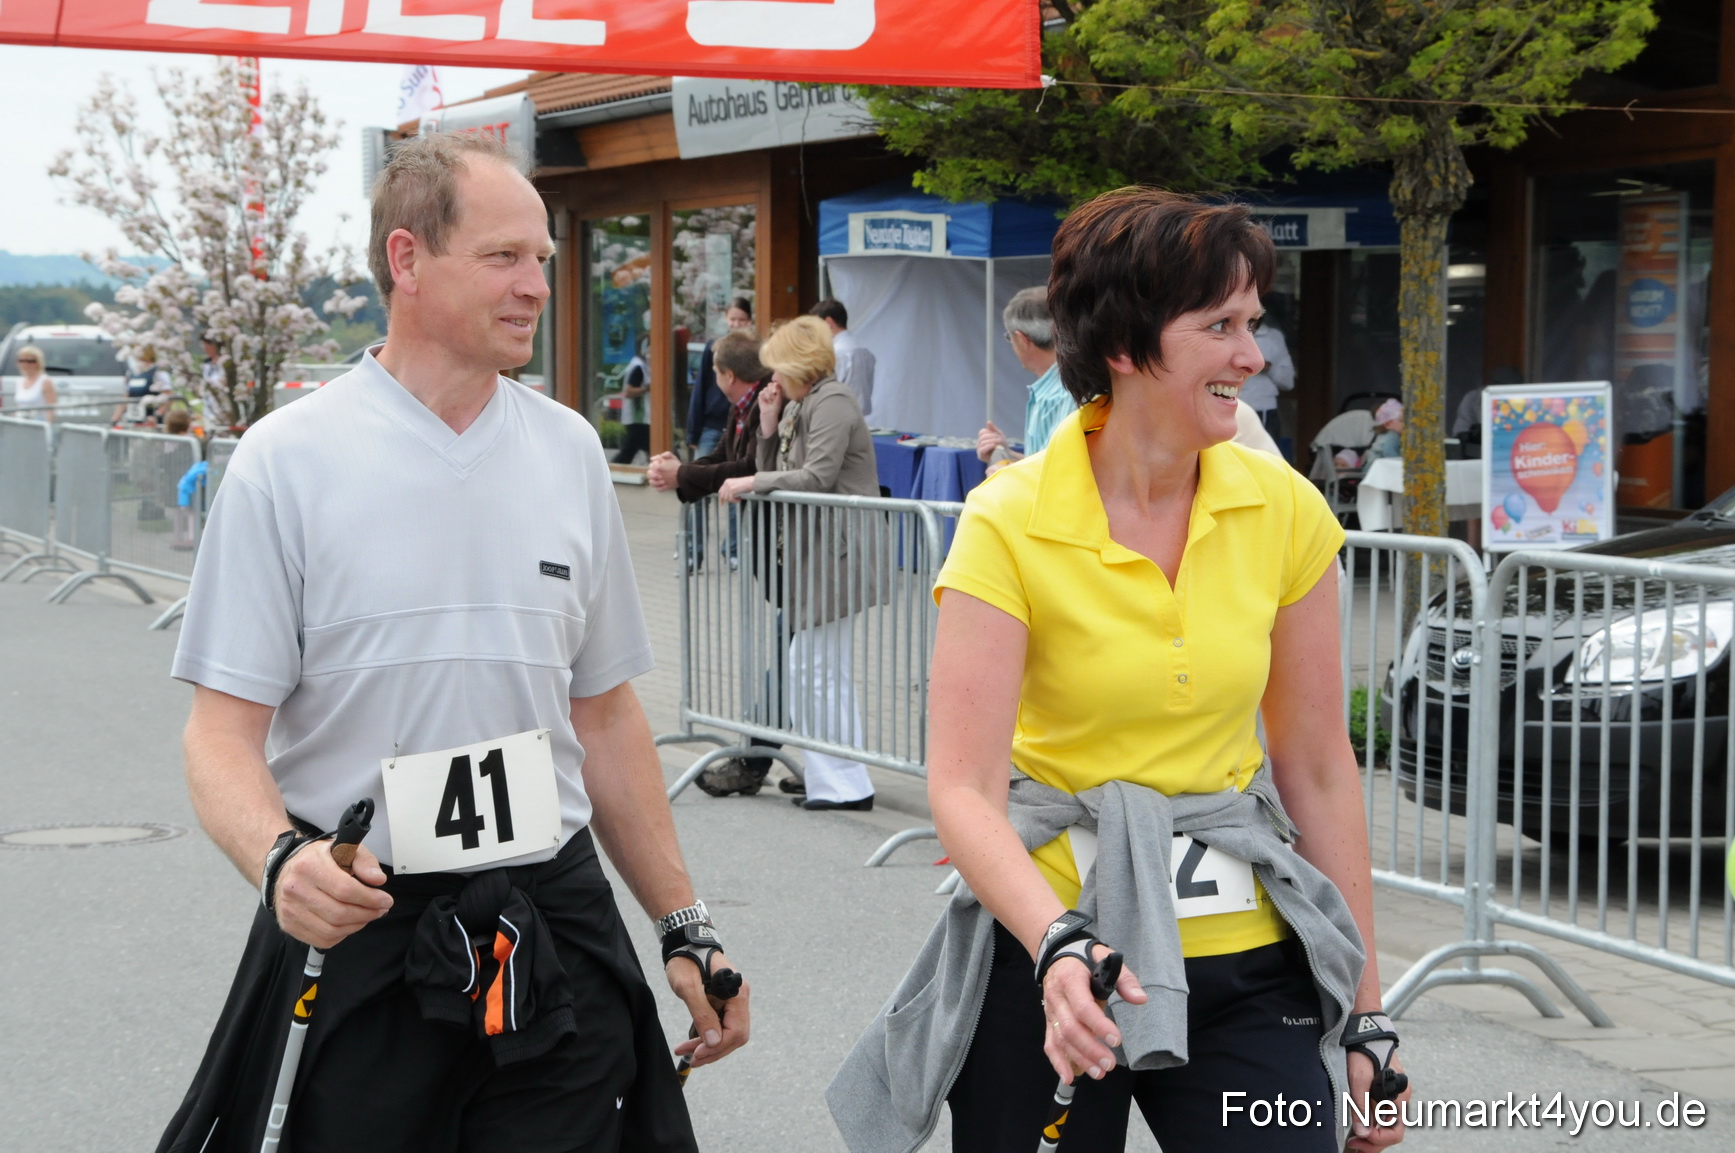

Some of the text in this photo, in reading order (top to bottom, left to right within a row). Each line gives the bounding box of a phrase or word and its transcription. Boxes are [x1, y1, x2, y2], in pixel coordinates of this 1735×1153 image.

[689, 86, 768, 127] Autohaus
[1514, 453, 1575, 469] Kinder-
[434, 747, 515, 851] 41
[1169, 831, 1220, 900] 2
